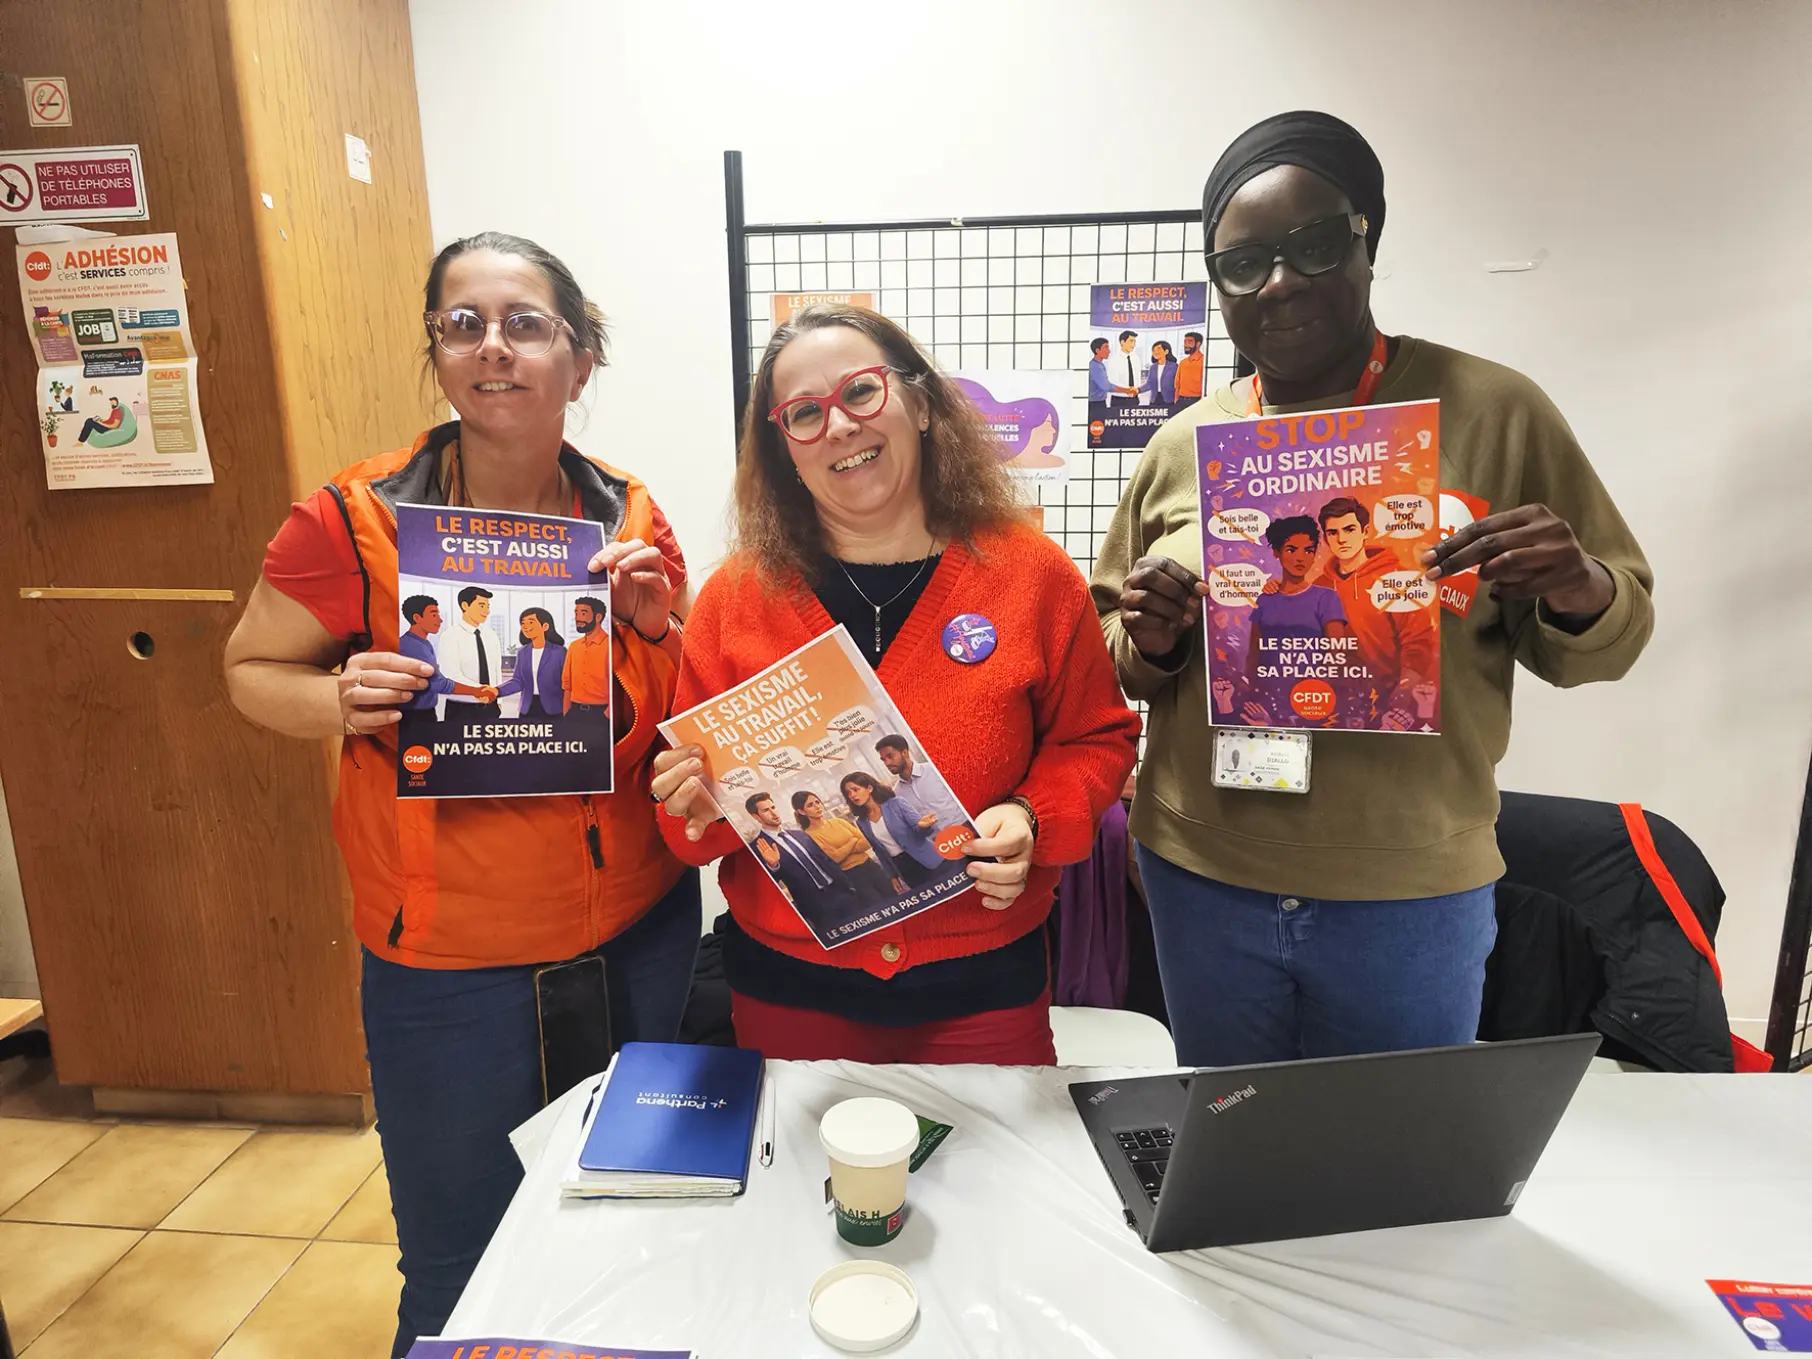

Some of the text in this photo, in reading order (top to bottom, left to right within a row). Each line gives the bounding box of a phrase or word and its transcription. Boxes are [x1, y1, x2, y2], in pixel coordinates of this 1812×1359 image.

[39, 163, 130, 177] NE PAS UTILISER
[41, 177, 132, 192] DE TÉLÉPHONES
[43, 193, 108, 206] PORTABLES
[58, 271, 79, 281] c'est
[80, 268, 126, 280] SERVICES
[128, 266, 166, 277] compris
[1109, 286, 1187, 300] LE RESPECT,
[788, 296, 800, 308] LE
[1112, 299, 1184, 312] C'EST AUSSI
[1111, 311, 1184, 323] AU TRAVAIL
[78, 323, 101, 336] JOB
[1119, 408, 1169, 417] LE SEXISME
[1120, 418, 1135, 426] PAS
[1136, 418, 1148, 426] SA
[1256, 410, 1366, 449] STOP
[1240, 441, 1389, 476] AU SEXISME
[1247, 465, 1383, 497] ORDINAIRE
[1386, 500, 1422, 510] Elle est
[1219, 513, 1258, 523] Sois belle
[1393, 512, 1414, 521] trop
[435, 515, 573, 544] LE RESPECT,
[1229, 524, 1259, 534] tais-toi
[1385, 521, 1425, 531] émotive
[441, 536, 568, 560] C'EST AUSSI
[441, 556, 573, 578] AU TRAVAIL
[1226, 569, 1242, 577] faut
[1215, 579, 1261, 588] vrai travail
[1382, 578, 1423, 589] Elle est
[1219, 590, 1259, 598] d'homme
[1377, 589, 1429, 603] plus jolie
[1440, 585, 1470, 612] CIAUX
[1258, 637, 1358, 650] LE SEXISME
[1279, 652, 1347, 665] N'A PAS
[1257, 665, 1373, 679] SA PLACE ICI.
[693, 660, 808, 733] LE SEXISME
[1293, 692, 1332, 703] CFDT
[713, 686, 823, 749] AU TRAVAIL,
[846, 710, 861, 721] bien
[851, 716, 866, 728] jolie
[463, 724, 553, 738] LE SEXISME
[732, 741, 759, 763] ÇA
[754, 709, 812, 750] SUFFIT
[433, 741, 587, 755] N'A PAS SA PLACE ICI.
[823, 741, 834, 750] est
[405, 755, 431, 763] Cfdt:
[776, 749, 788, 759] vrai
[773, 756, 792, 769] travail
[809, 756, 823, 766] trop
[938, 831, 972, 853] Cfdt:
[826, 871, 969, 940] LE SEXISME N'A PAS SA PLACE
[638, 1092, 708, 1100] consultant
[1207, 1084, 1258, 1115] ThinkPad
[636, 1097, 707, 1110] Parthena
[871, 1210, 880, 1220] H
